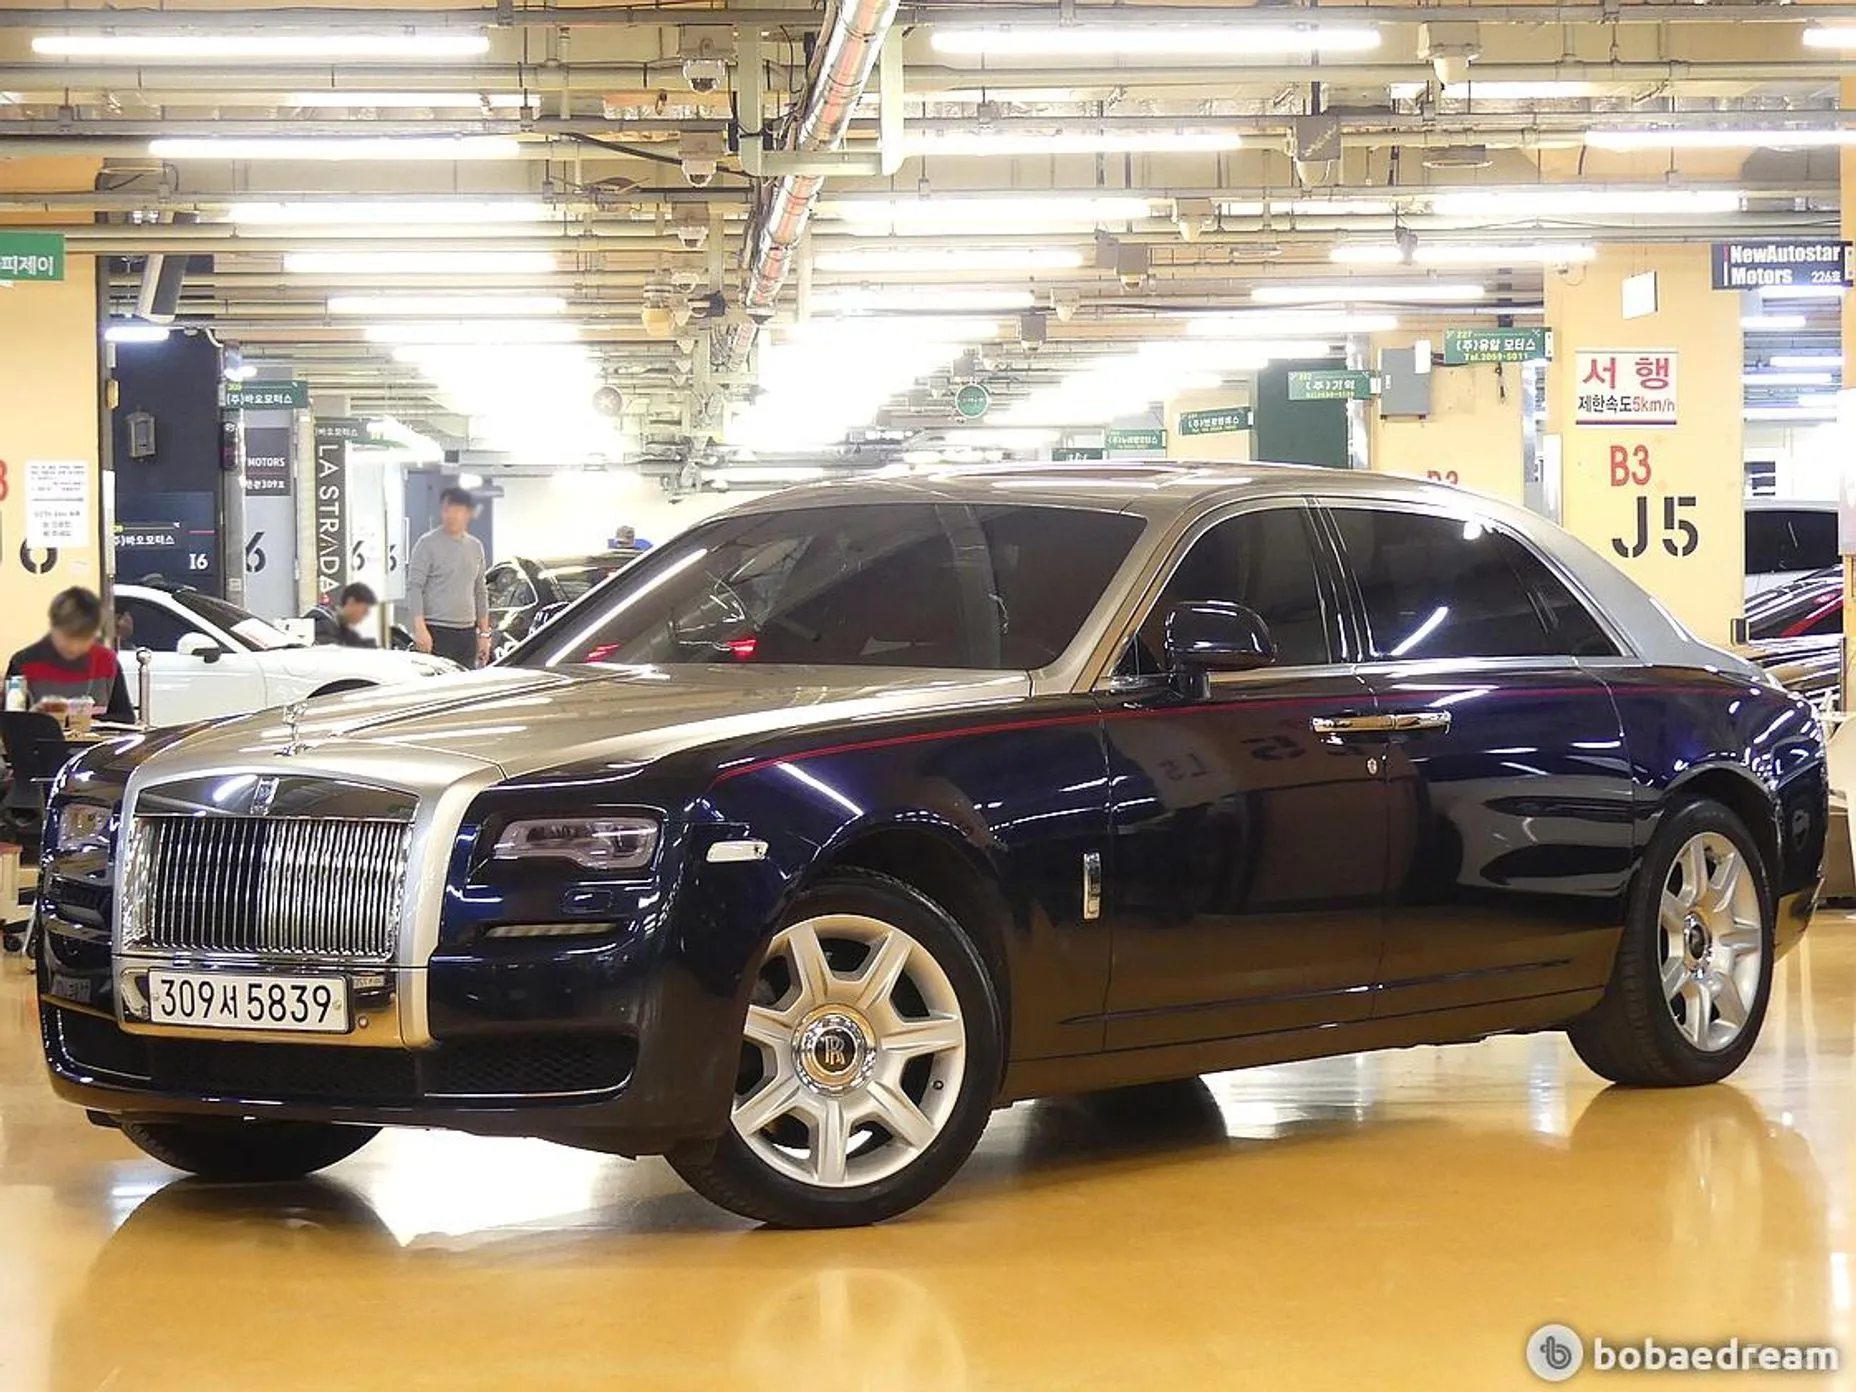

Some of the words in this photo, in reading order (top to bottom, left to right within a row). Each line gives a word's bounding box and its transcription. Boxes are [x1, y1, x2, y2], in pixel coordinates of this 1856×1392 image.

[1730, 245, 1840, 264] NewAutostar
[1731, 267, 1793, 285] Motors
[248, 457, 285, 468] MOTORS
[319, 444, 339, 478] LA
[1611, 444, 1652, 487] B3
[1612, 496, 1698, 558] J5
[160, 979, 239, 1019] 309서
[247, 982, 332, 1023] 5839
